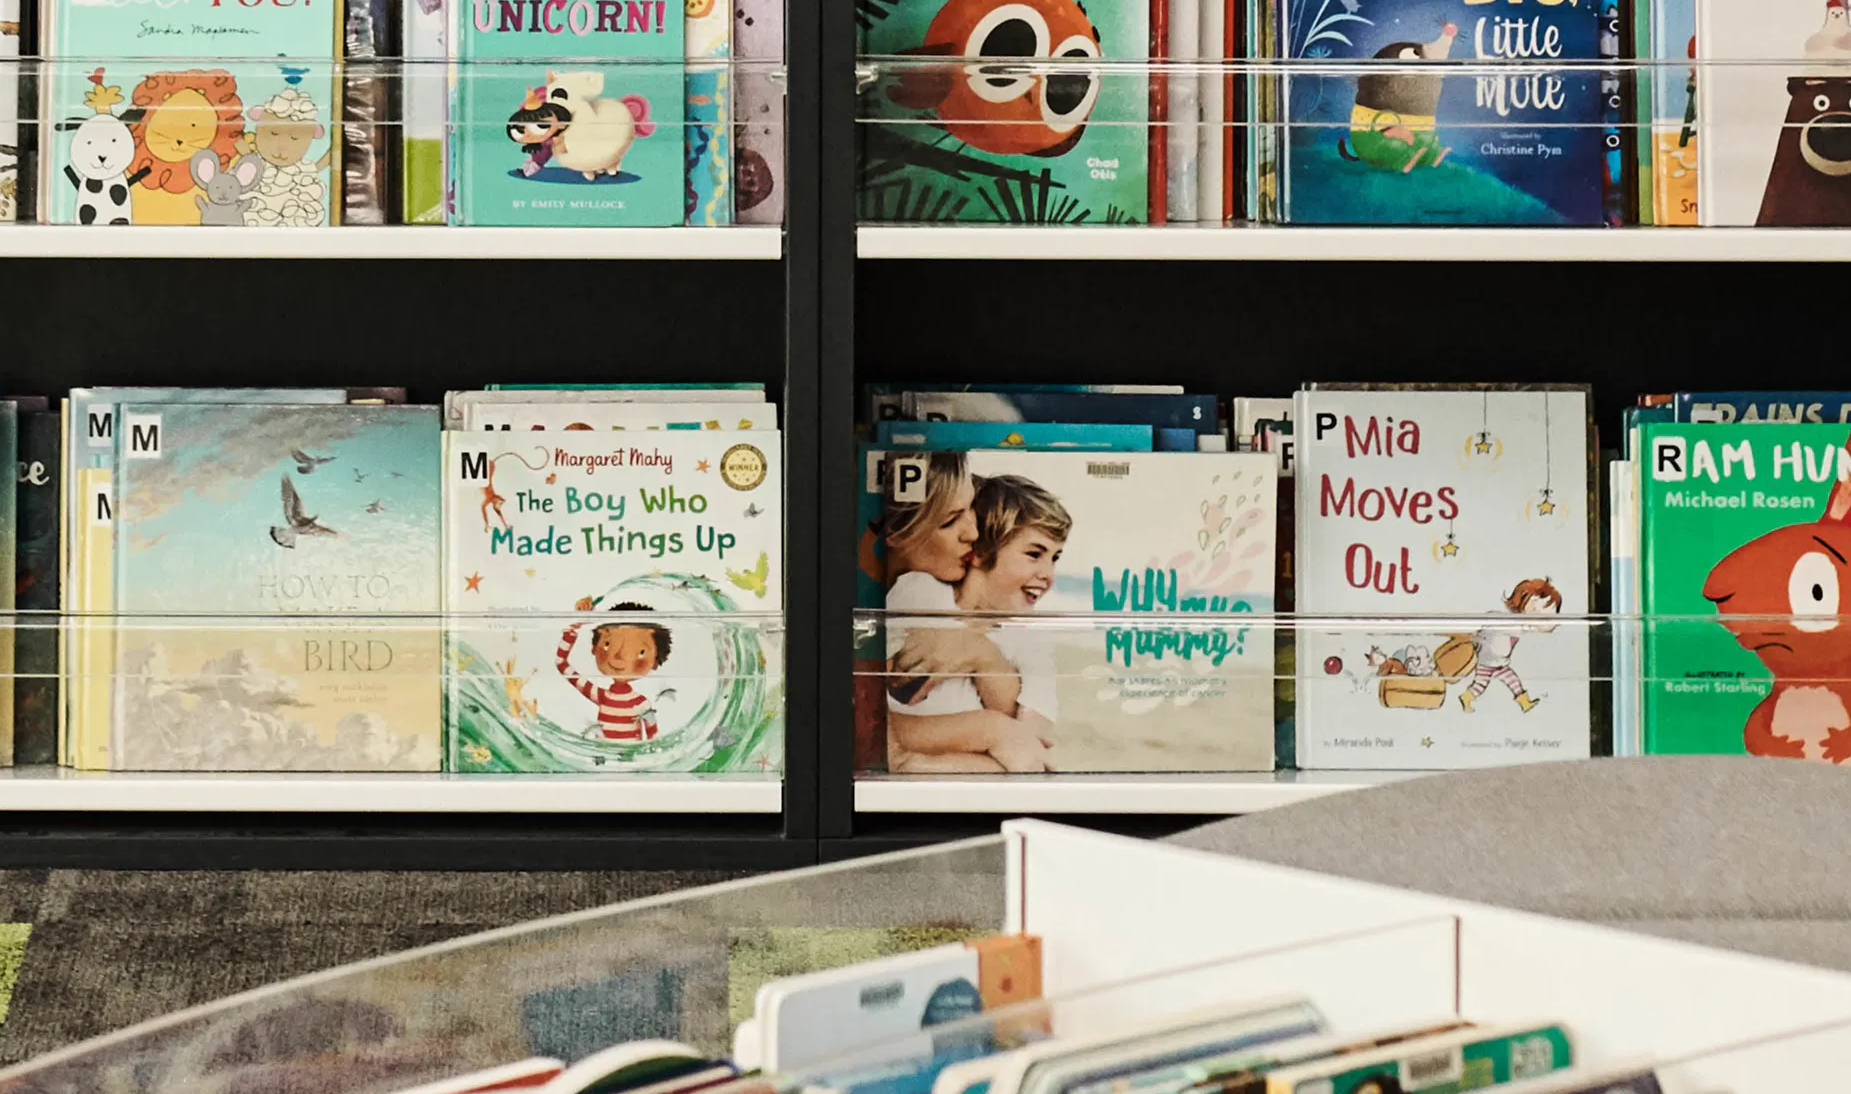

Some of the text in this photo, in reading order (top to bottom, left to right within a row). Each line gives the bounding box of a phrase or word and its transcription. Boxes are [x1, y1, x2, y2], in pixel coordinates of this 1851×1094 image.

[1474, 16, 1563, 59] Little
[1481, 142, 1562, 159] Christine Pym
[531, 200, 567, 209] EMILY
[89, 413, 112, 438] M
[1345, 415, 1421, 459] Mia
[460, 451, 488, 479] M
[554, 448, 673, 475] Margaret Mahy
[1658, 444, 1682, 472] R
[516, 485, 709, 521] The Boy Who
[1320, 474, 1460, 524] Moves
[1665, 491, 1816, 509] Michael Rosen
[490, 524, 737, 560] Made Things Up
[1345, 543, 1420, 594] Out
[347, 573, 391, 600] TO
[303, 639, 394, 673] BIRD
[1665, 682, 1710, 694] Robert
